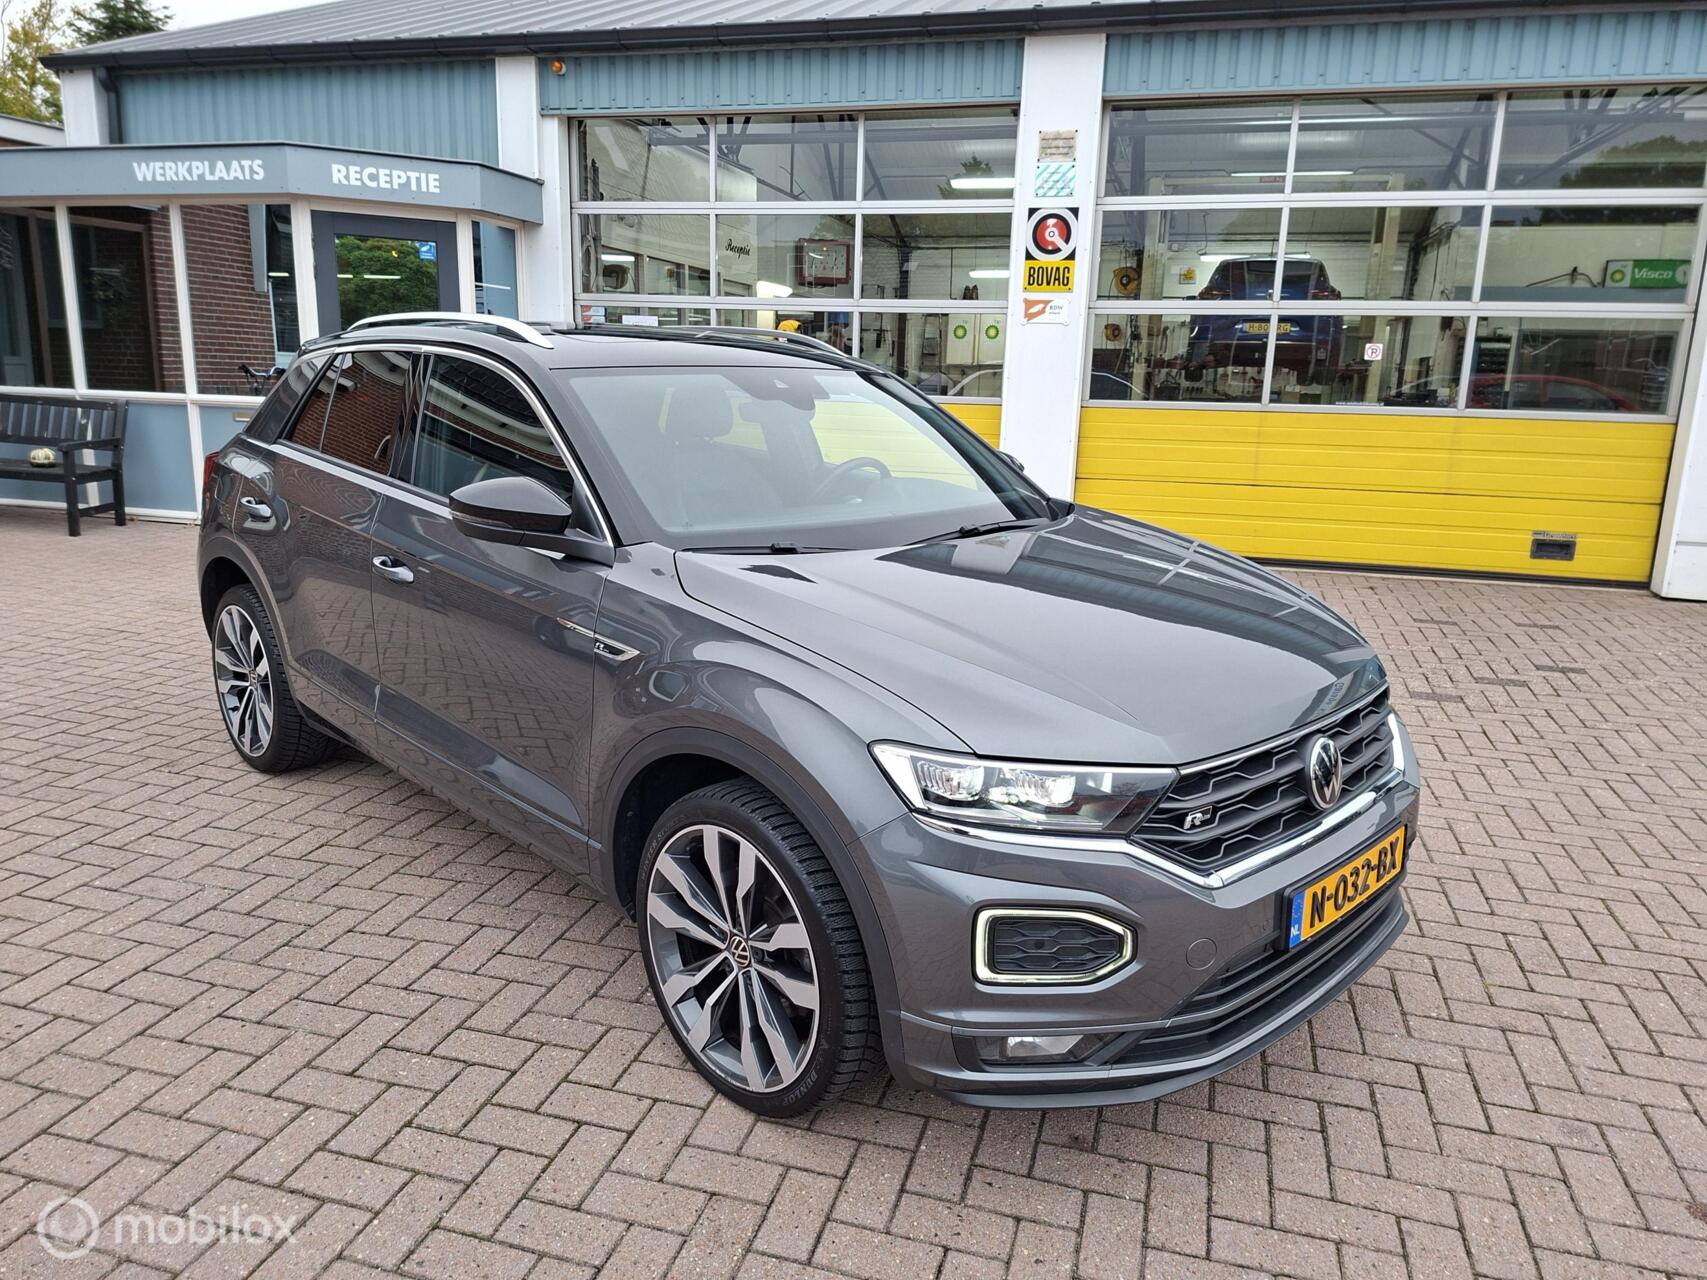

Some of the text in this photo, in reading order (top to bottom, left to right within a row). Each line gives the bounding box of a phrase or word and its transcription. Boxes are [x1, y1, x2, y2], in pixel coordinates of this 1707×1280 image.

[133, 159, 265, 183] WERKPLAATS
[331, 163, 441, 194] RECEPTIE
[1027, 266, 1070, 287] BOVAG
[1309, 836, 1400, 929] N-032-BX
[1290, 925, 1300, 937] NL
